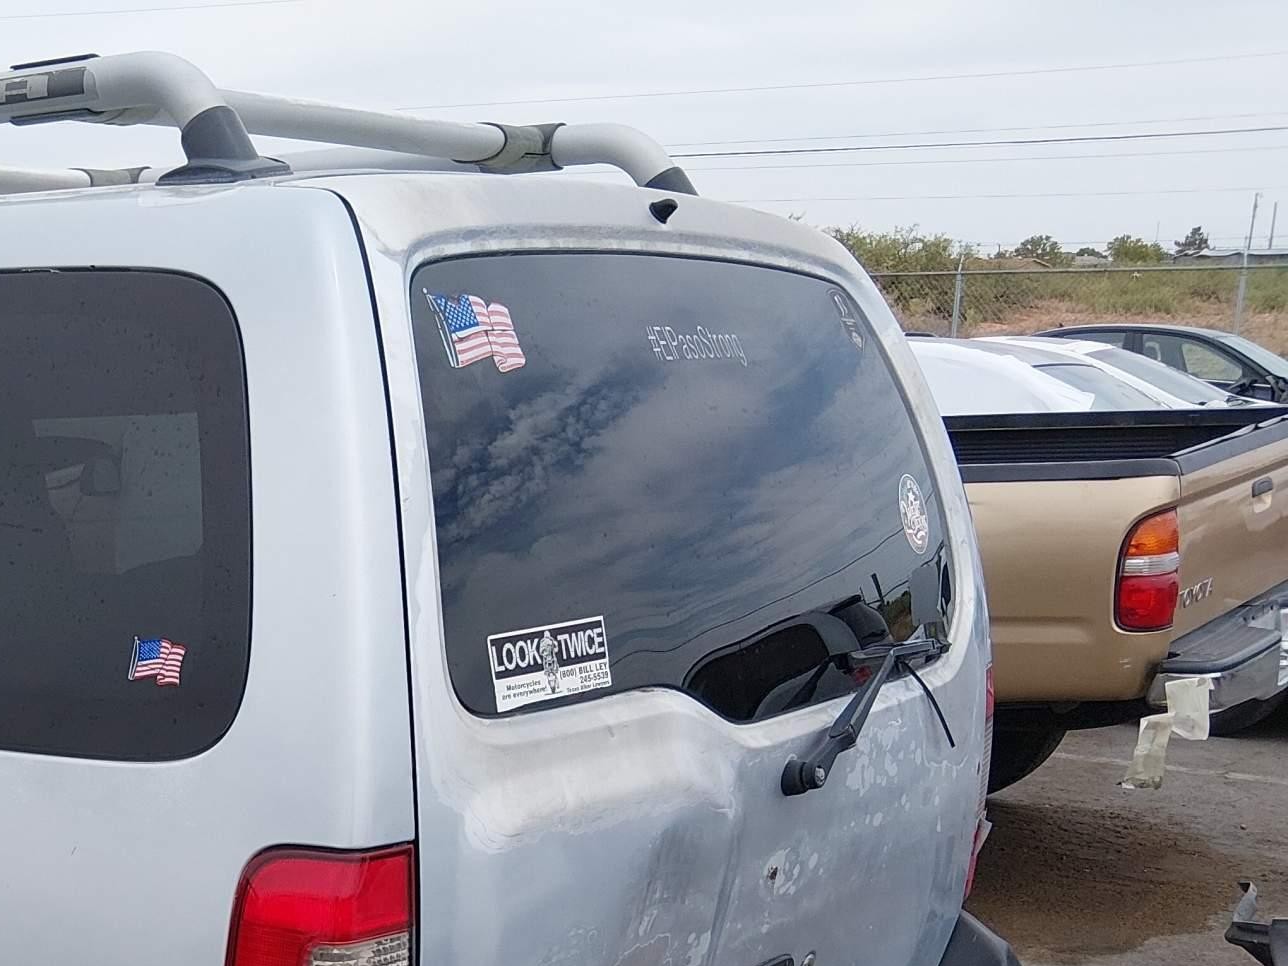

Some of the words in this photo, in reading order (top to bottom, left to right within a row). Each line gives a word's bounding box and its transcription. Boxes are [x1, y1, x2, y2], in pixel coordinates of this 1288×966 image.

[646, 325, 747, 367] #ElPasoStrong
[492, 638, 542, 672] LOOK
[557, 627, 604, 660] TWICE
[579, 665, 593, 674] BILL
[595, 662, 608, 671] LEY
[506, 680, 541, 691] Motorcycles
